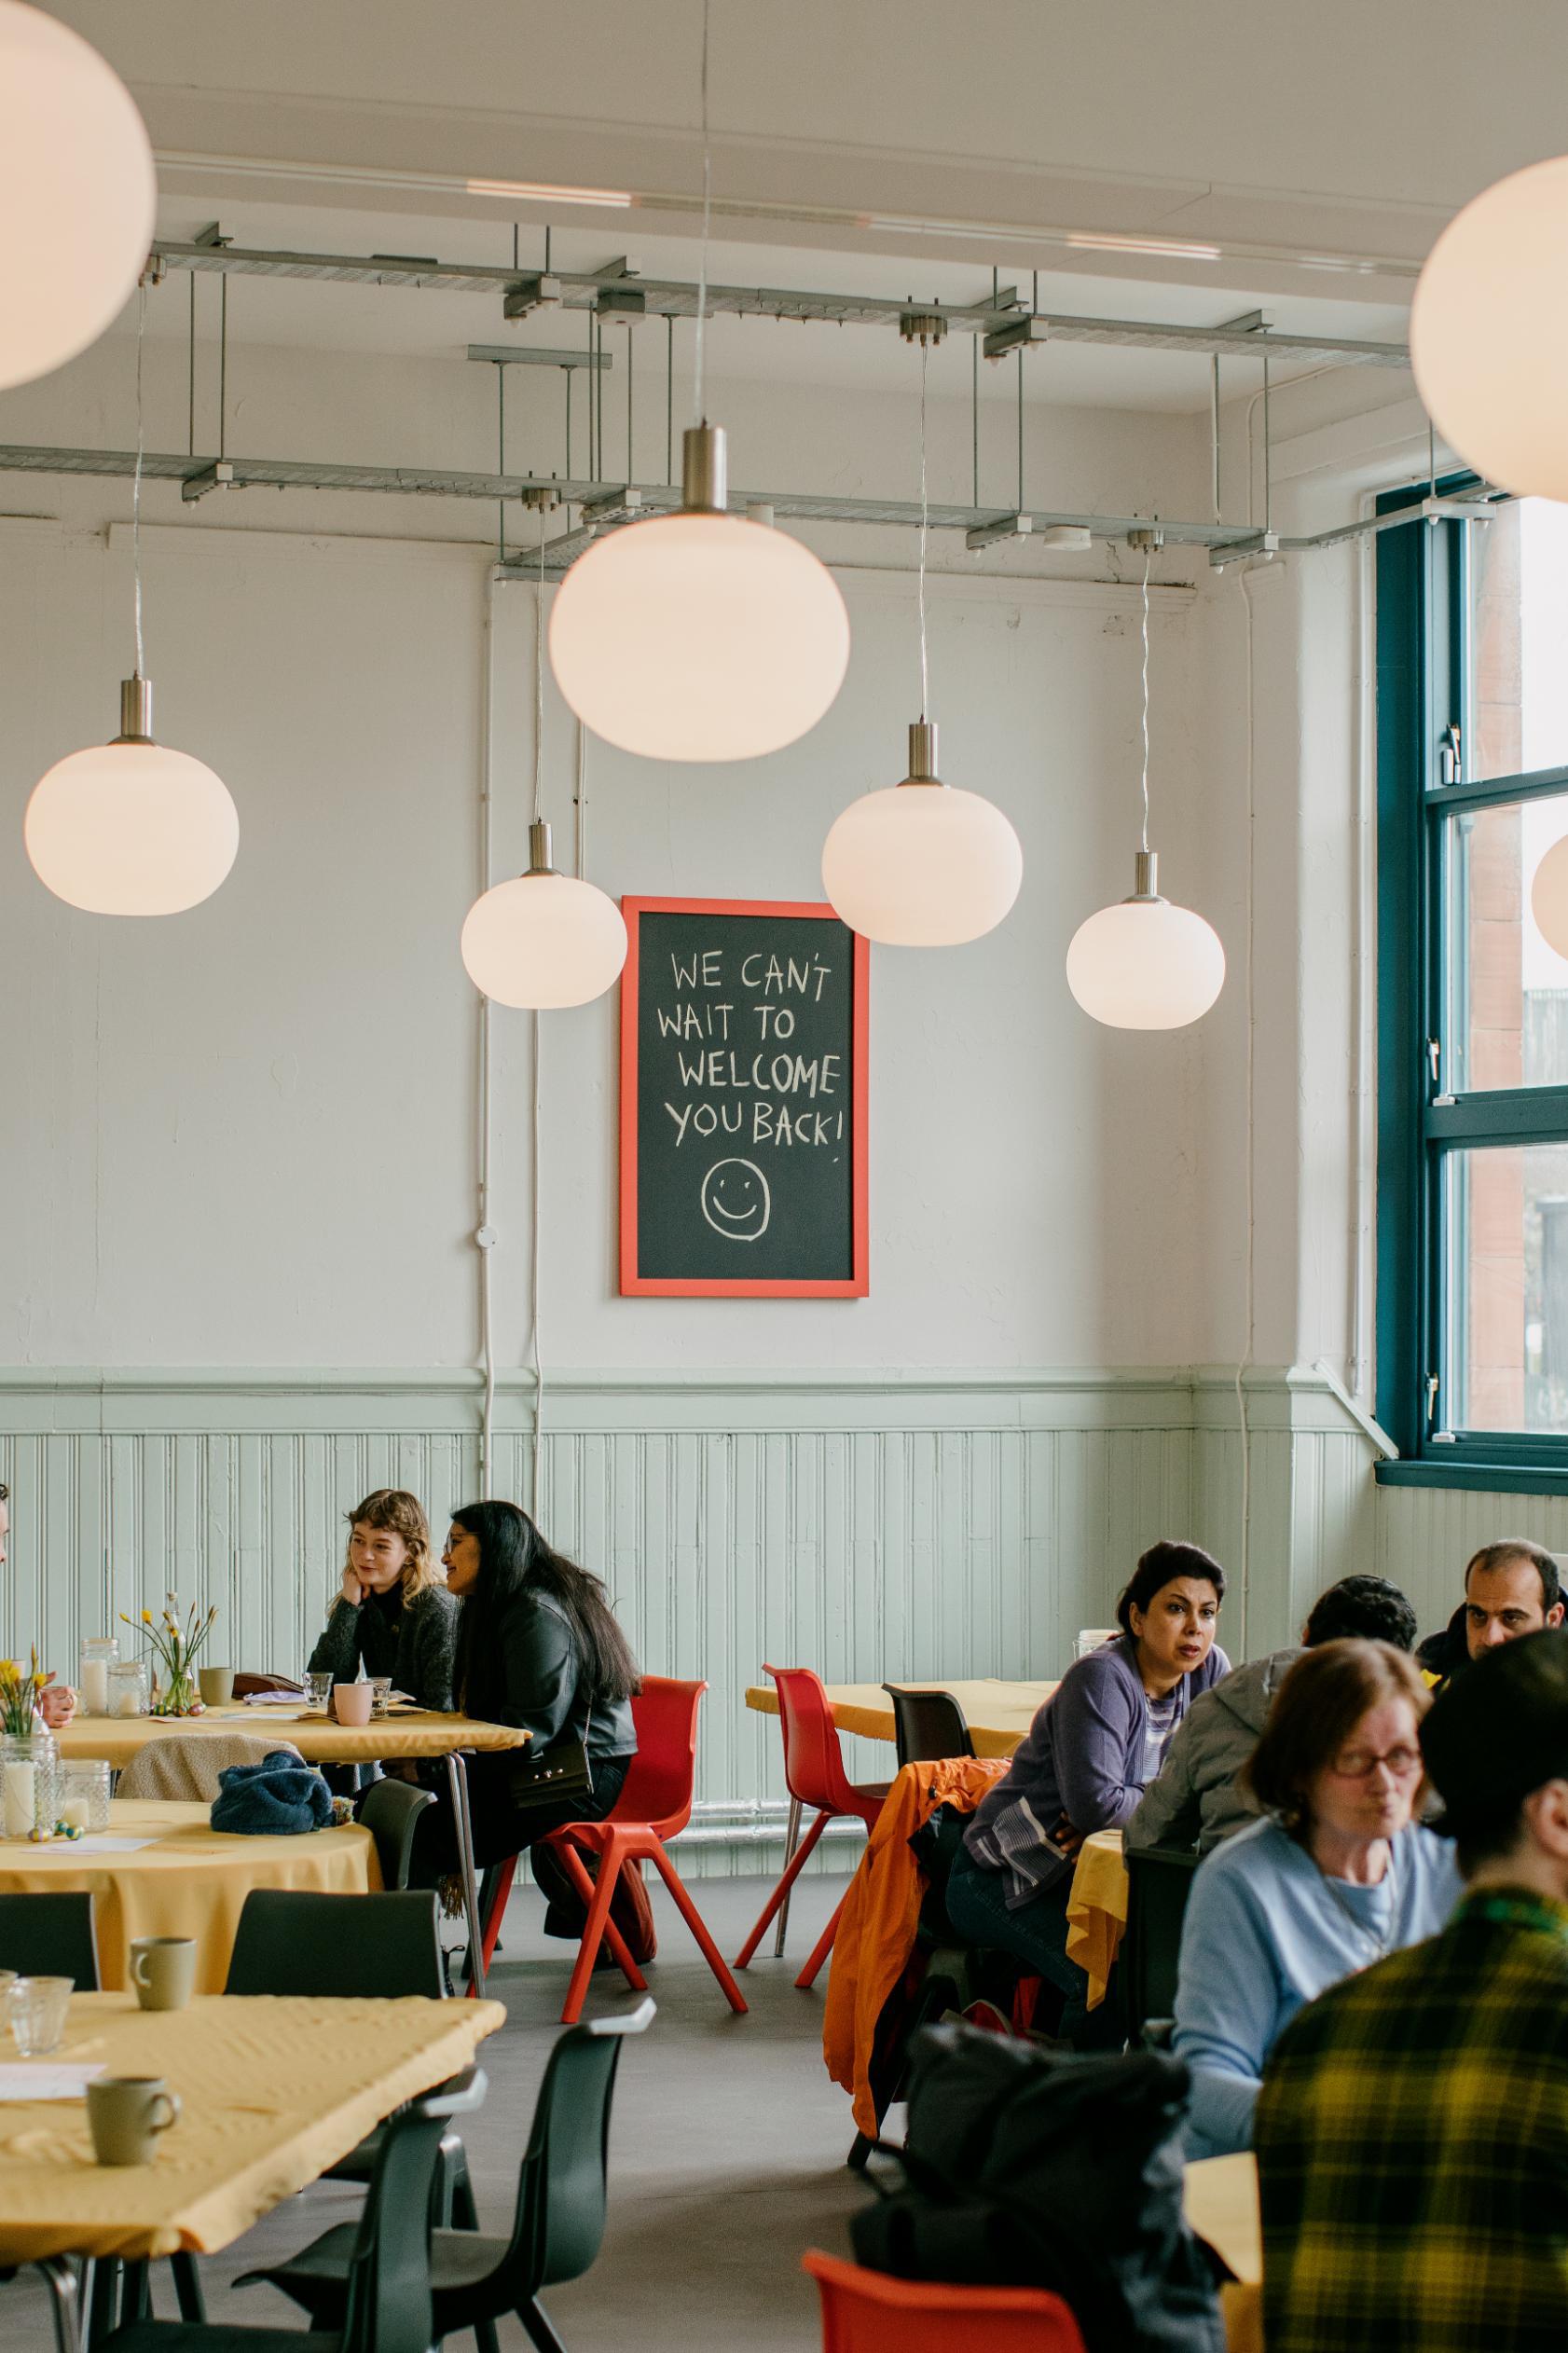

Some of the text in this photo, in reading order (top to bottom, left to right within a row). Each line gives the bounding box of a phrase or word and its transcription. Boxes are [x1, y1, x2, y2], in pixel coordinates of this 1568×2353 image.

[671, 951, 832, 1001] WE CAN'T
[657, 1003, 795, 1041] WAIT TO
[678, 1050, 841, 1098] WELCOME
[664, 1102, 843, 1163] YOU BACK!
